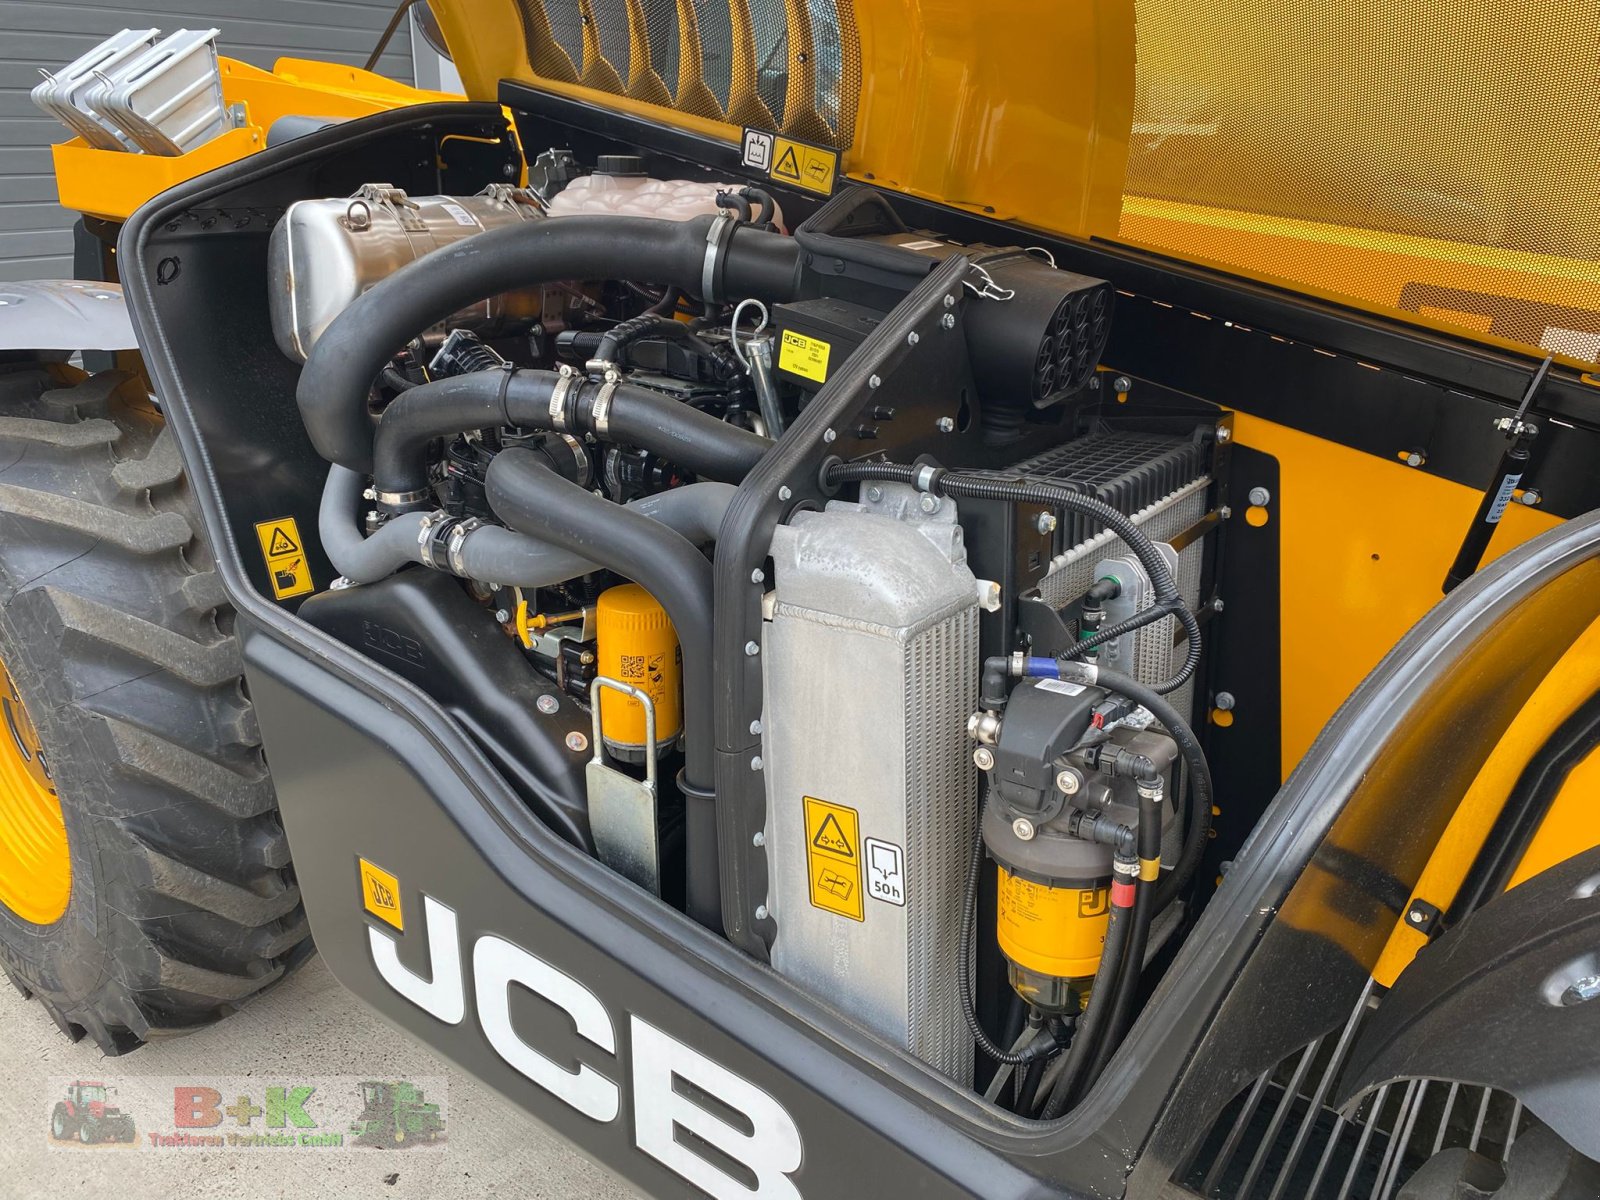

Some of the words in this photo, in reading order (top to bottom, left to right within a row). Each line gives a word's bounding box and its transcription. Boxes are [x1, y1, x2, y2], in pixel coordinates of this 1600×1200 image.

[784, 333, 807, 349] JCB
[371, 877, 395, 908] JCB
[368, 894, 803, 1200] JCB
